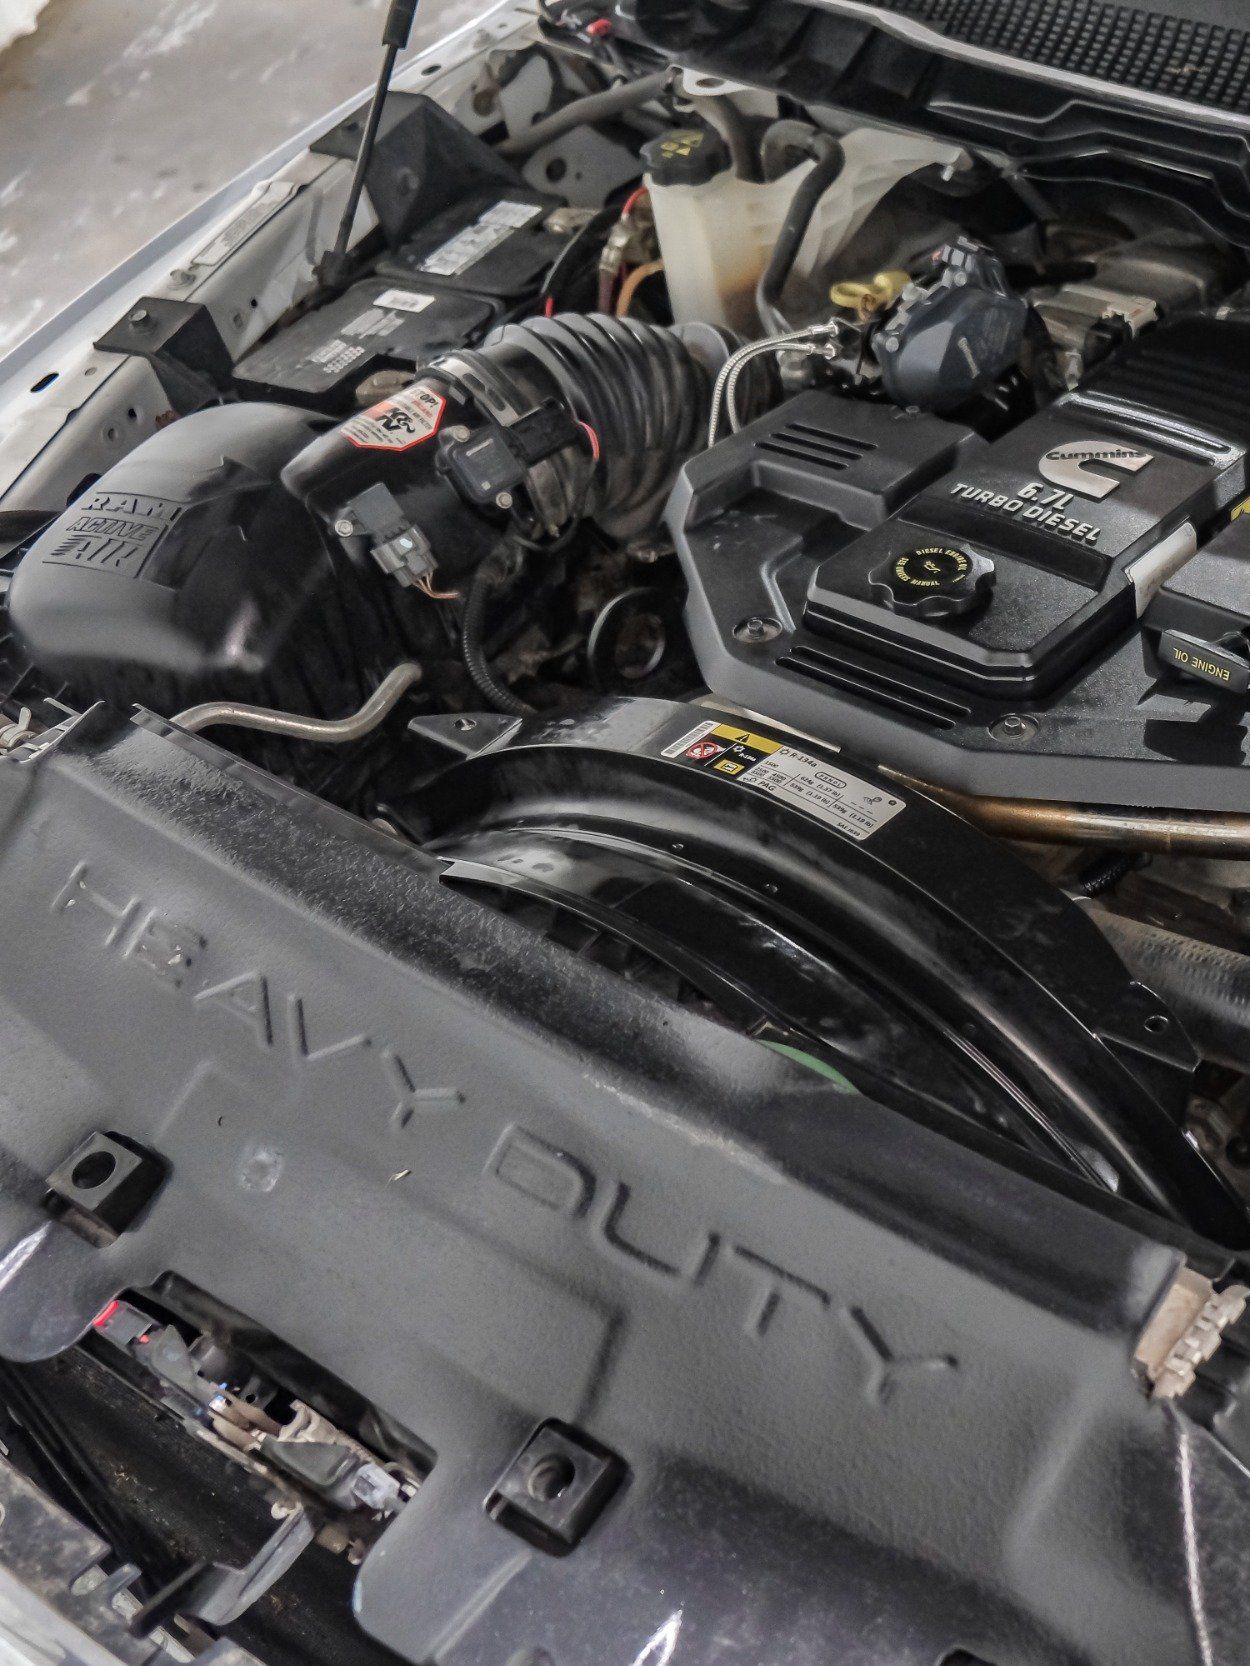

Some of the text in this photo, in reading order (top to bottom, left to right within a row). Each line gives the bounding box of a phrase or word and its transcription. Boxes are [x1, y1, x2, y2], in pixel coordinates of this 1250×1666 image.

[1045, 449, 1147, 460] Cummins
[81, 496, 183, 521] RAM
[1017, 482, 1075, 511] 6.7L
[950, 483, 1101, 542] TURBO DIESEL
[66, 516, 162, 542] ACTIVE
[70, 537, 145, 568] AIR
[915, 547, 943, 556] DIESEL
[910, 579, 940, 587] MANUAL
[1173, 647, 1230, 681] ENGINE OIL
[790, 752, 818, 768] R-134a
[758, 781, 777, 792] PAG
[50, 862, 959, 1406] HEAVY DUTY
